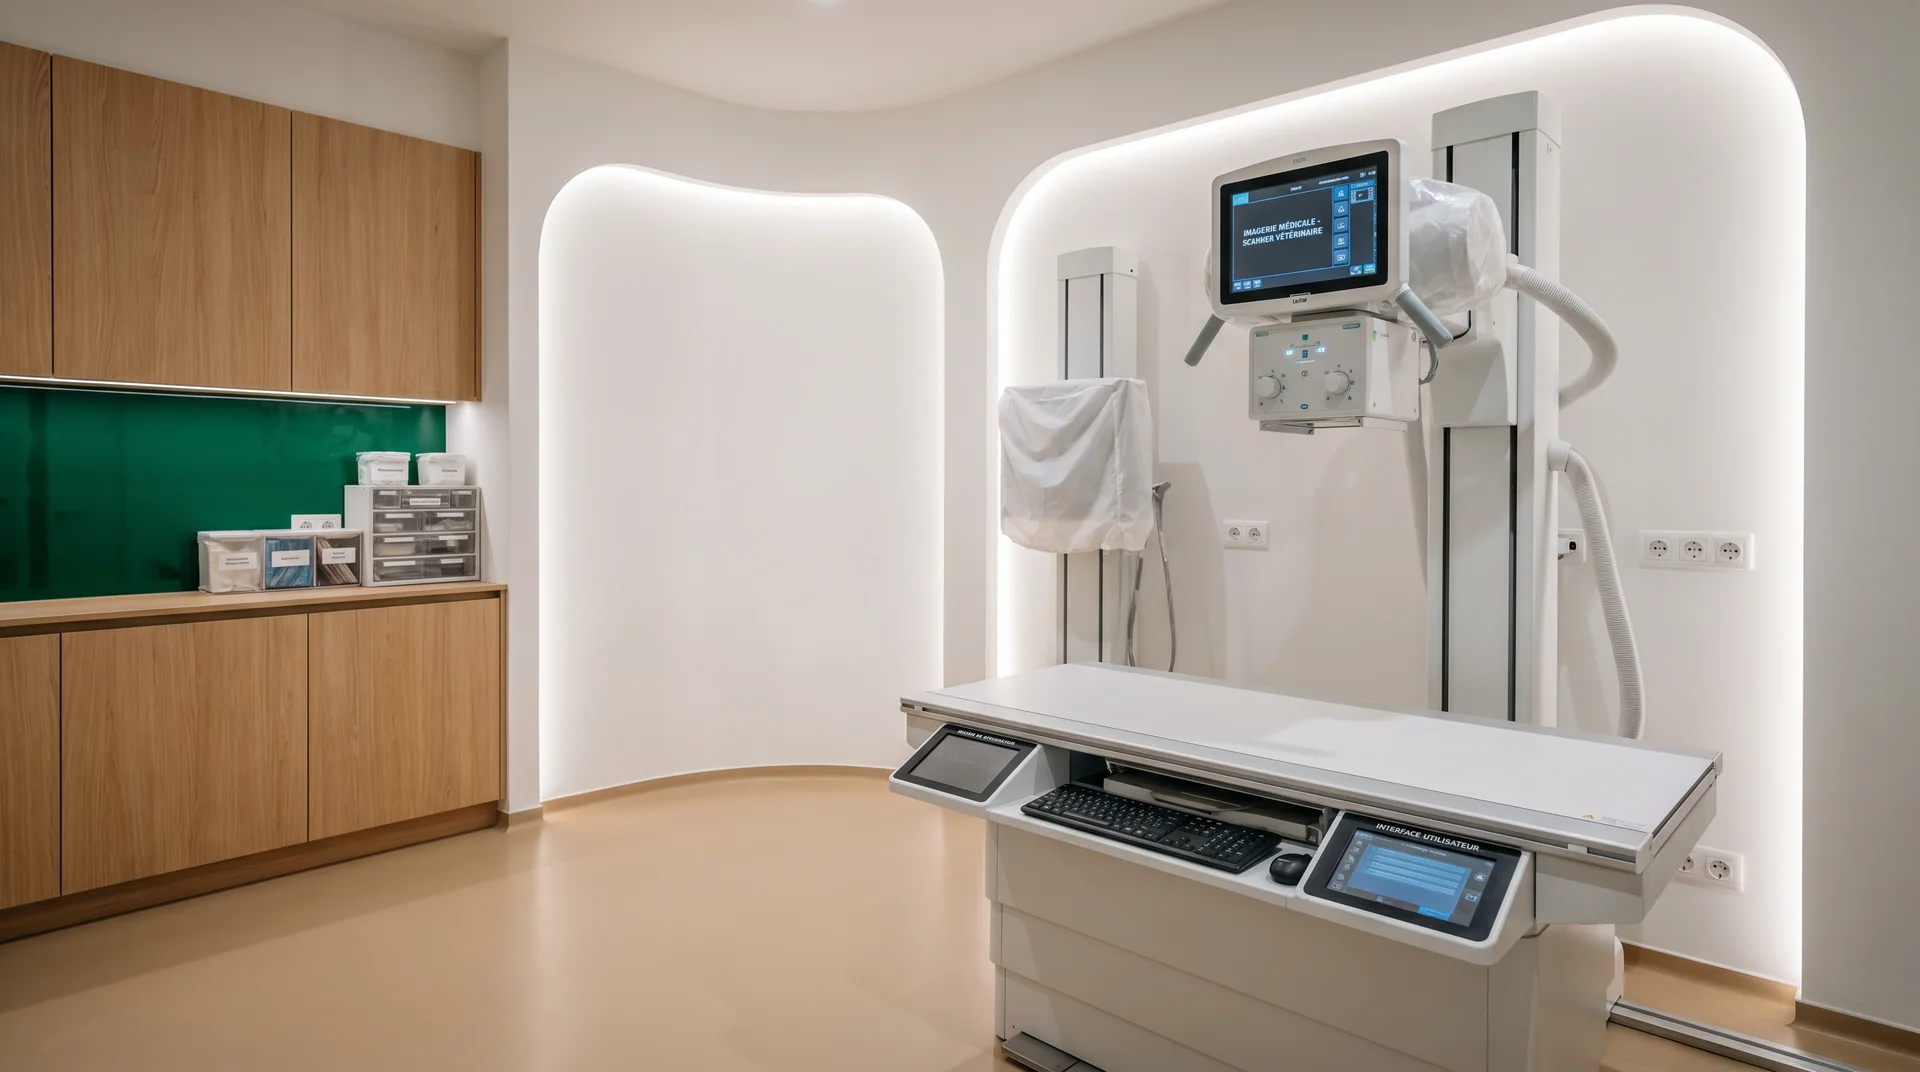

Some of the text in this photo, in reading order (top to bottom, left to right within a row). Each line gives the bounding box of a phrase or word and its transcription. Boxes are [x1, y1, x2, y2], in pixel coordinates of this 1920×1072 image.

[1243, 224, 1277, 237] IMAGERIE
[1278, 217, 1316, 231] MÉDICALE
[1375, 823, 1422, 839] INTERFACE
[1422, 833, 1480, 852] UTILISATEUR
